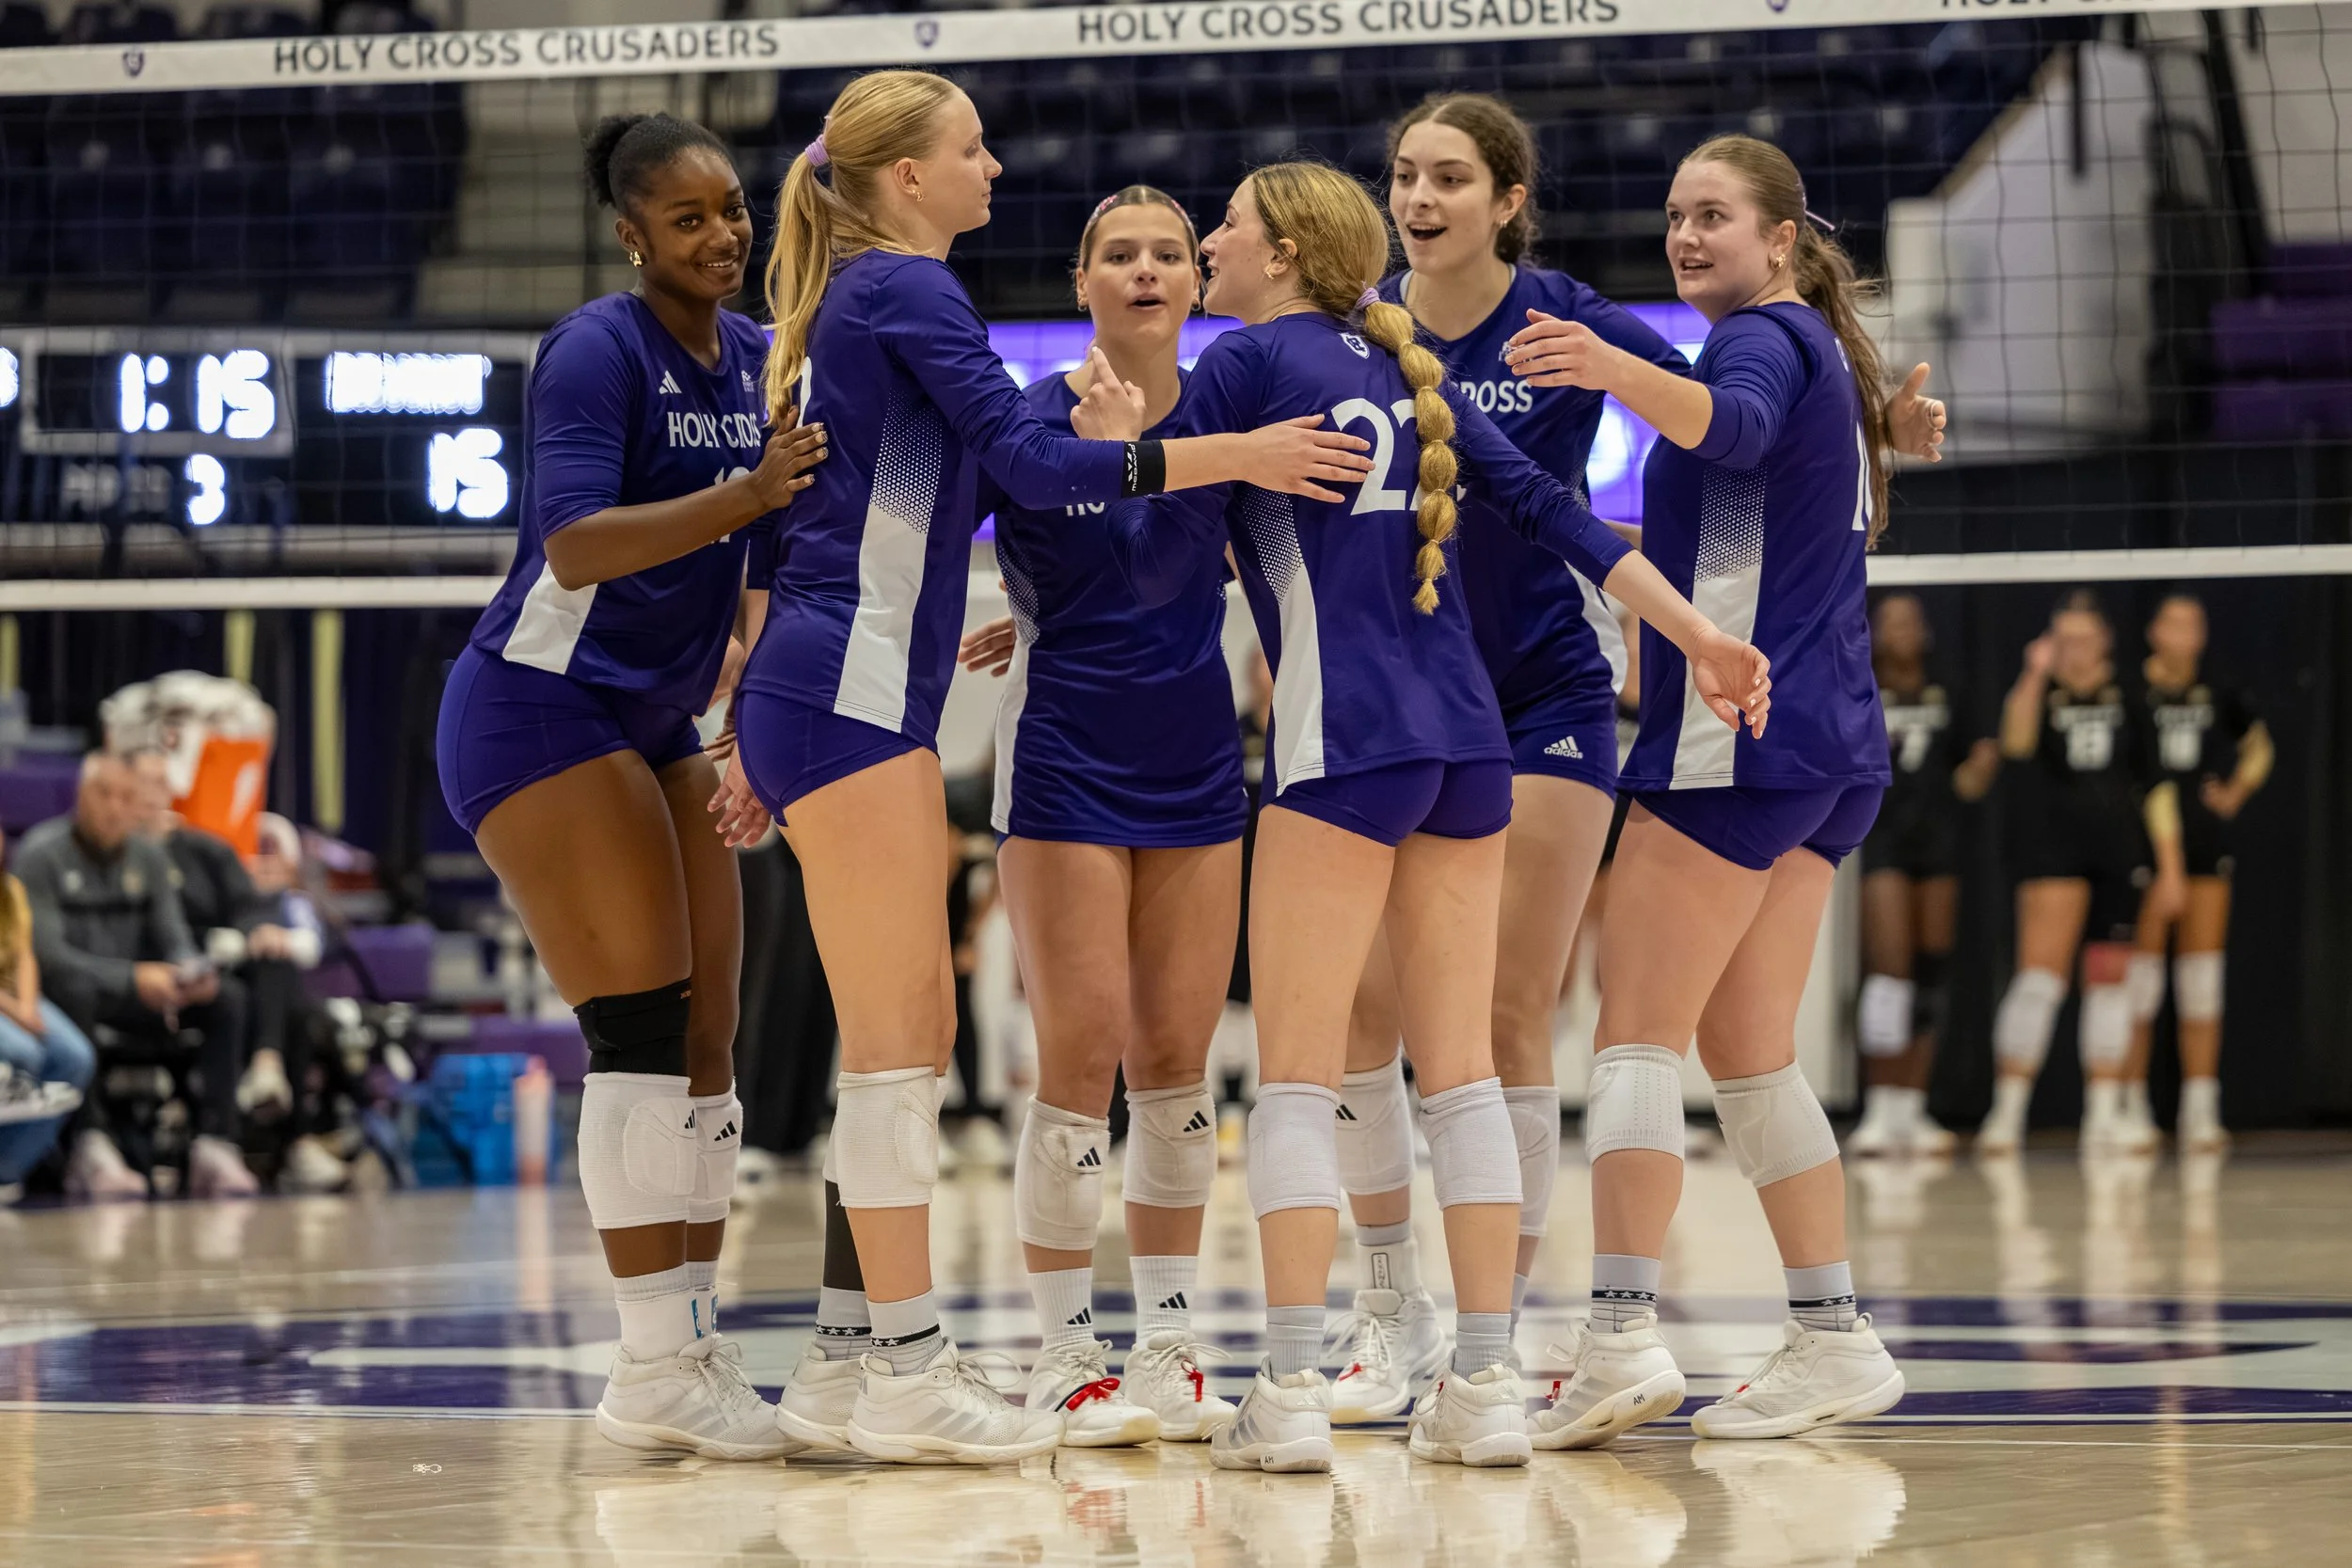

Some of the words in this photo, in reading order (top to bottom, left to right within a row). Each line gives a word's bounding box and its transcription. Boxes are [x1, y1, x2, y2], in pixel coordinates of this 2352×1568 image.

[1077, 9, 1185, 43] HOLY
[1200, 4, 1343, 40] CROSS
[1359, 0, 1619, 33] CRUSADERS
[274, 37, 374, 73] HOLY
[387, 33, 521, 70] CROSS
[535, 24, 779, 65] CRUSADERS
[1451, 379, 1534, 413] OSS
[667, 411, 721, 449] HOLY
[186, 453, 225, 525] 3
[429, 428, 508, 518] 15
[1544, 747, 1583, 759] adidas
[1632, 1393, 1645, 1406] AM
[1264, 1455, 1274, 1465] AM
